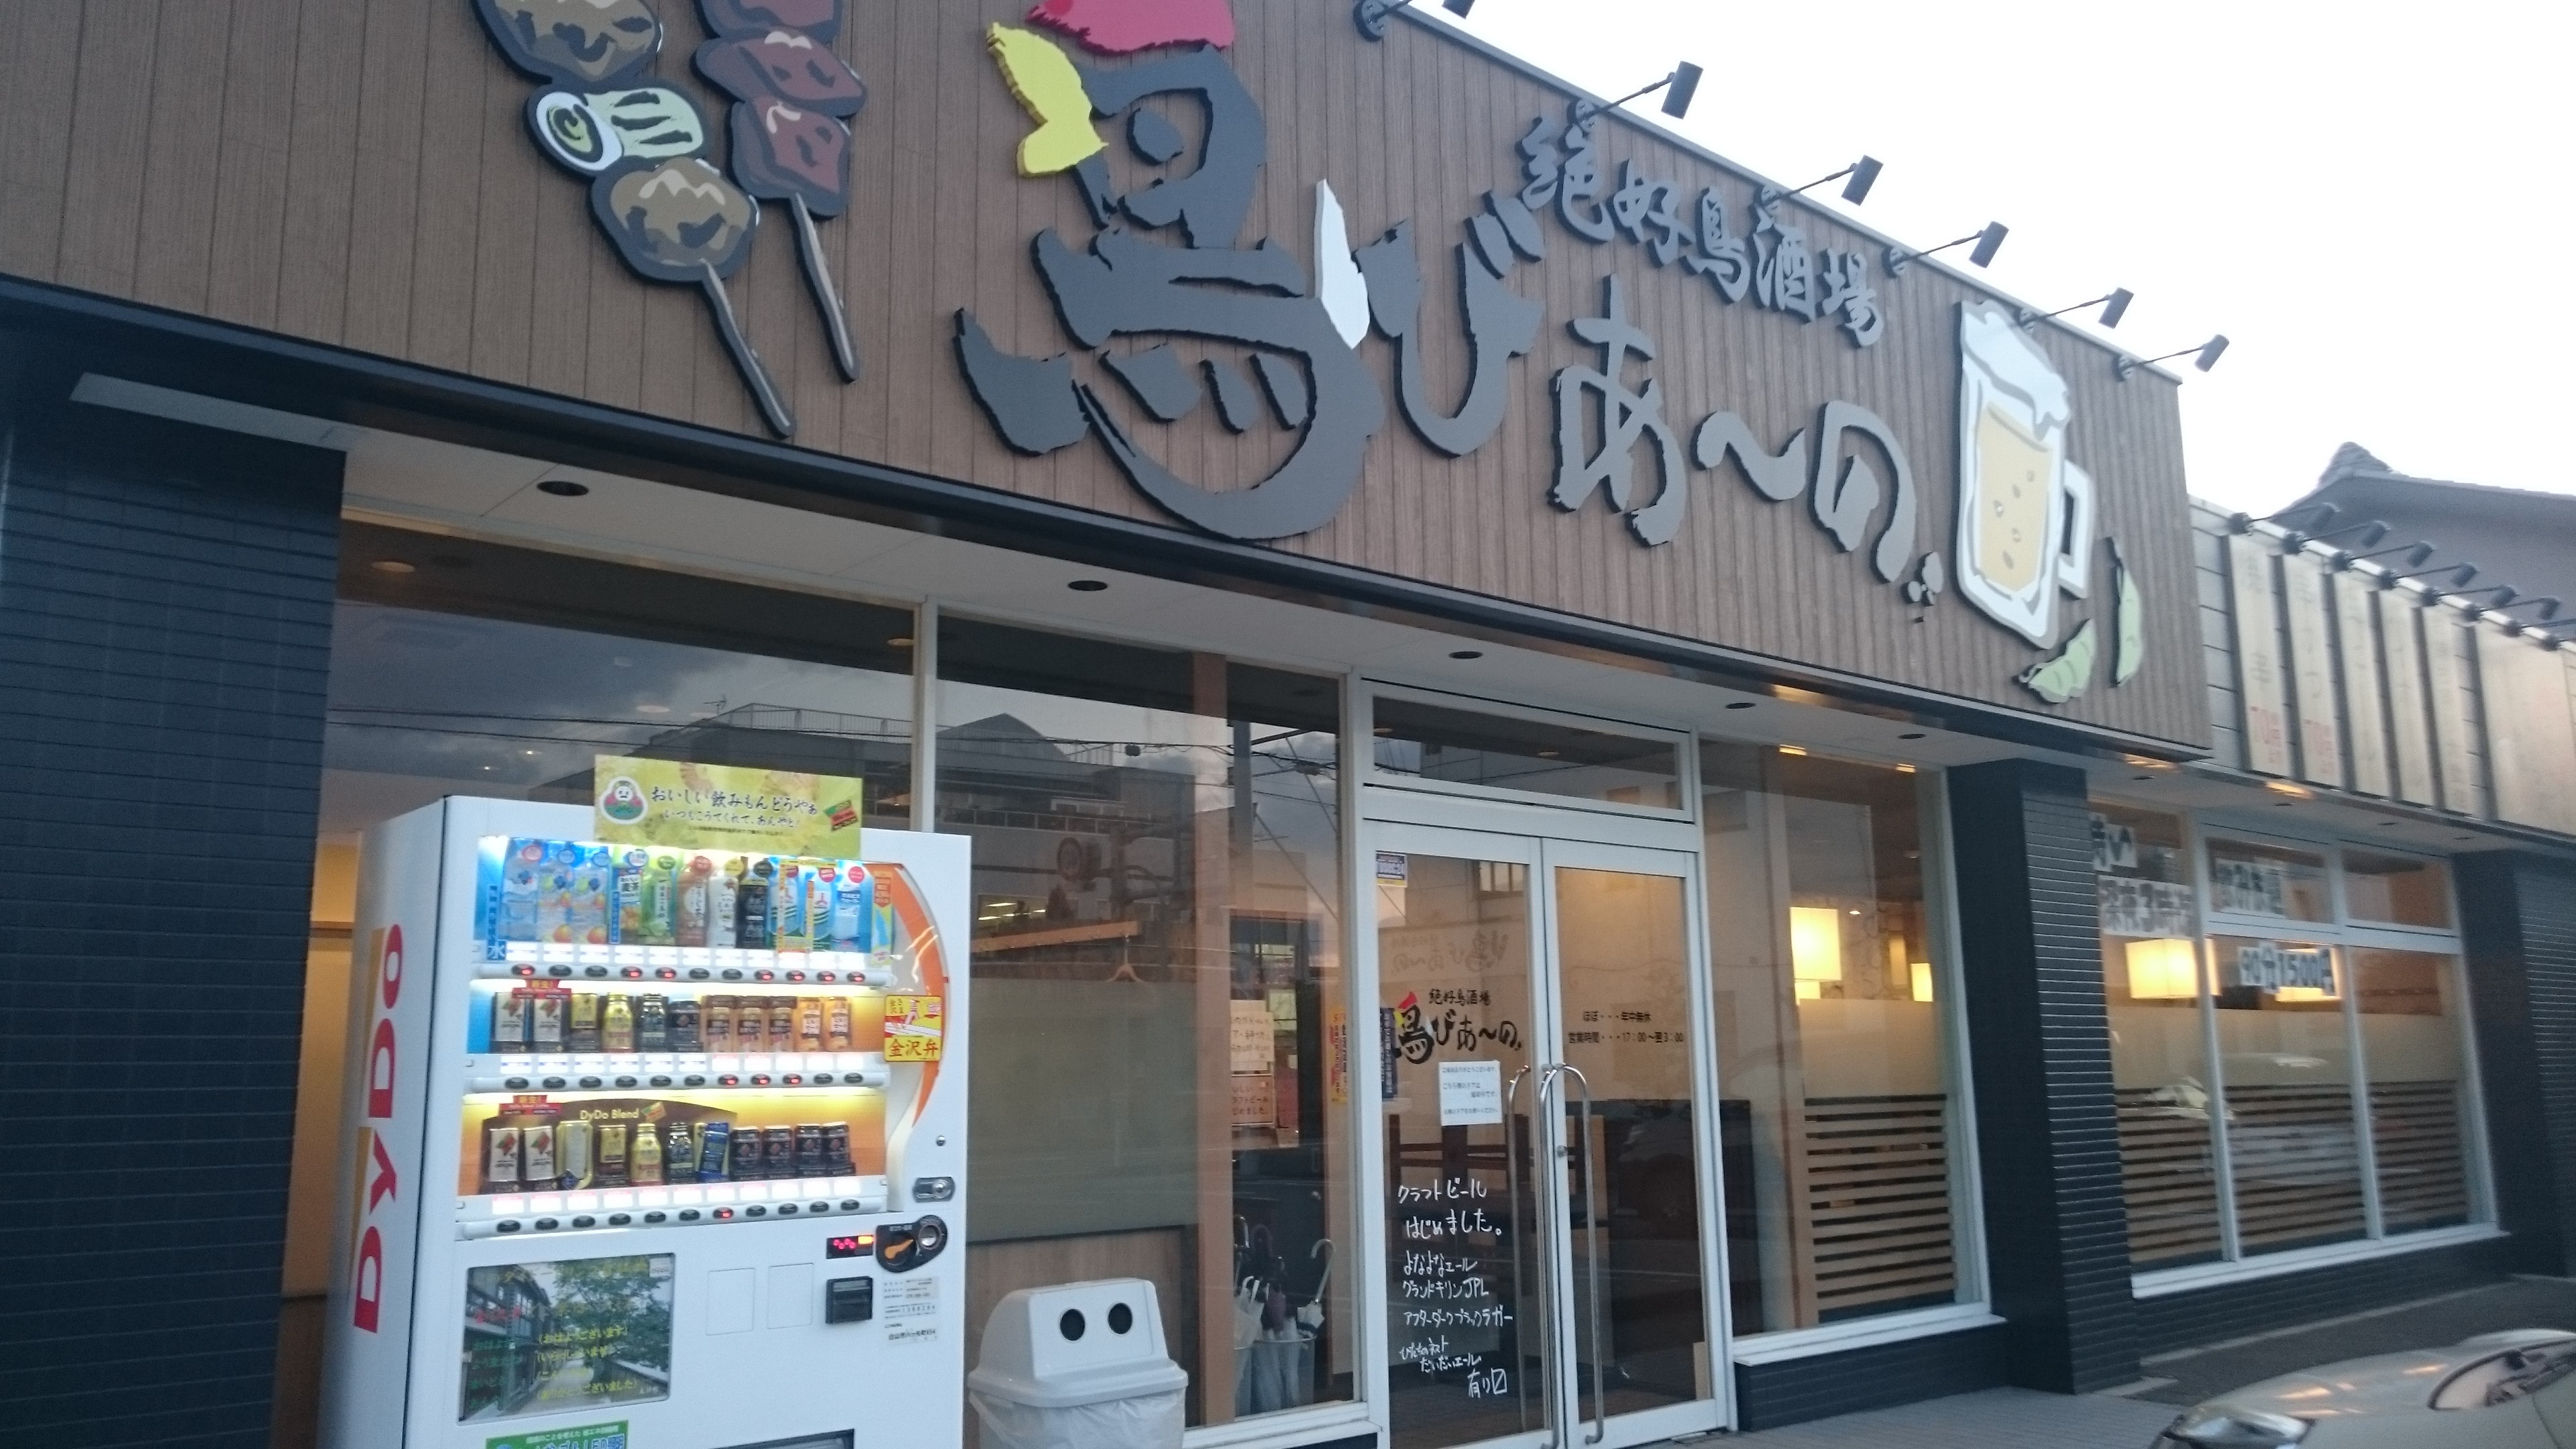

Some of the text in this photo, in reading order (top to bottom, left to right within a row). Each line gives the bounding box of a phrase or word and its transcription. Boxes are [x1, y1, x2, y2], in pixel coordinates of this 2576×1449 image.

[1516, 115, 1885, 348] 絶好鳥酒場
[1429, 988, 1492, 1006] 絶好鳥酒場
[889, 1038, 938, 1057] 金沢弁
[580, 1108, 639, 1123] DyDo Blend
[1397, 1177, 1487, 1204] クラフトビール
[1405, 1208, 1502, 1240] はじめました。
[1403, 1250, 1478, 1277] よなよなエール
[1403, 1277, 1489, 1299] グランドキリンJPL
